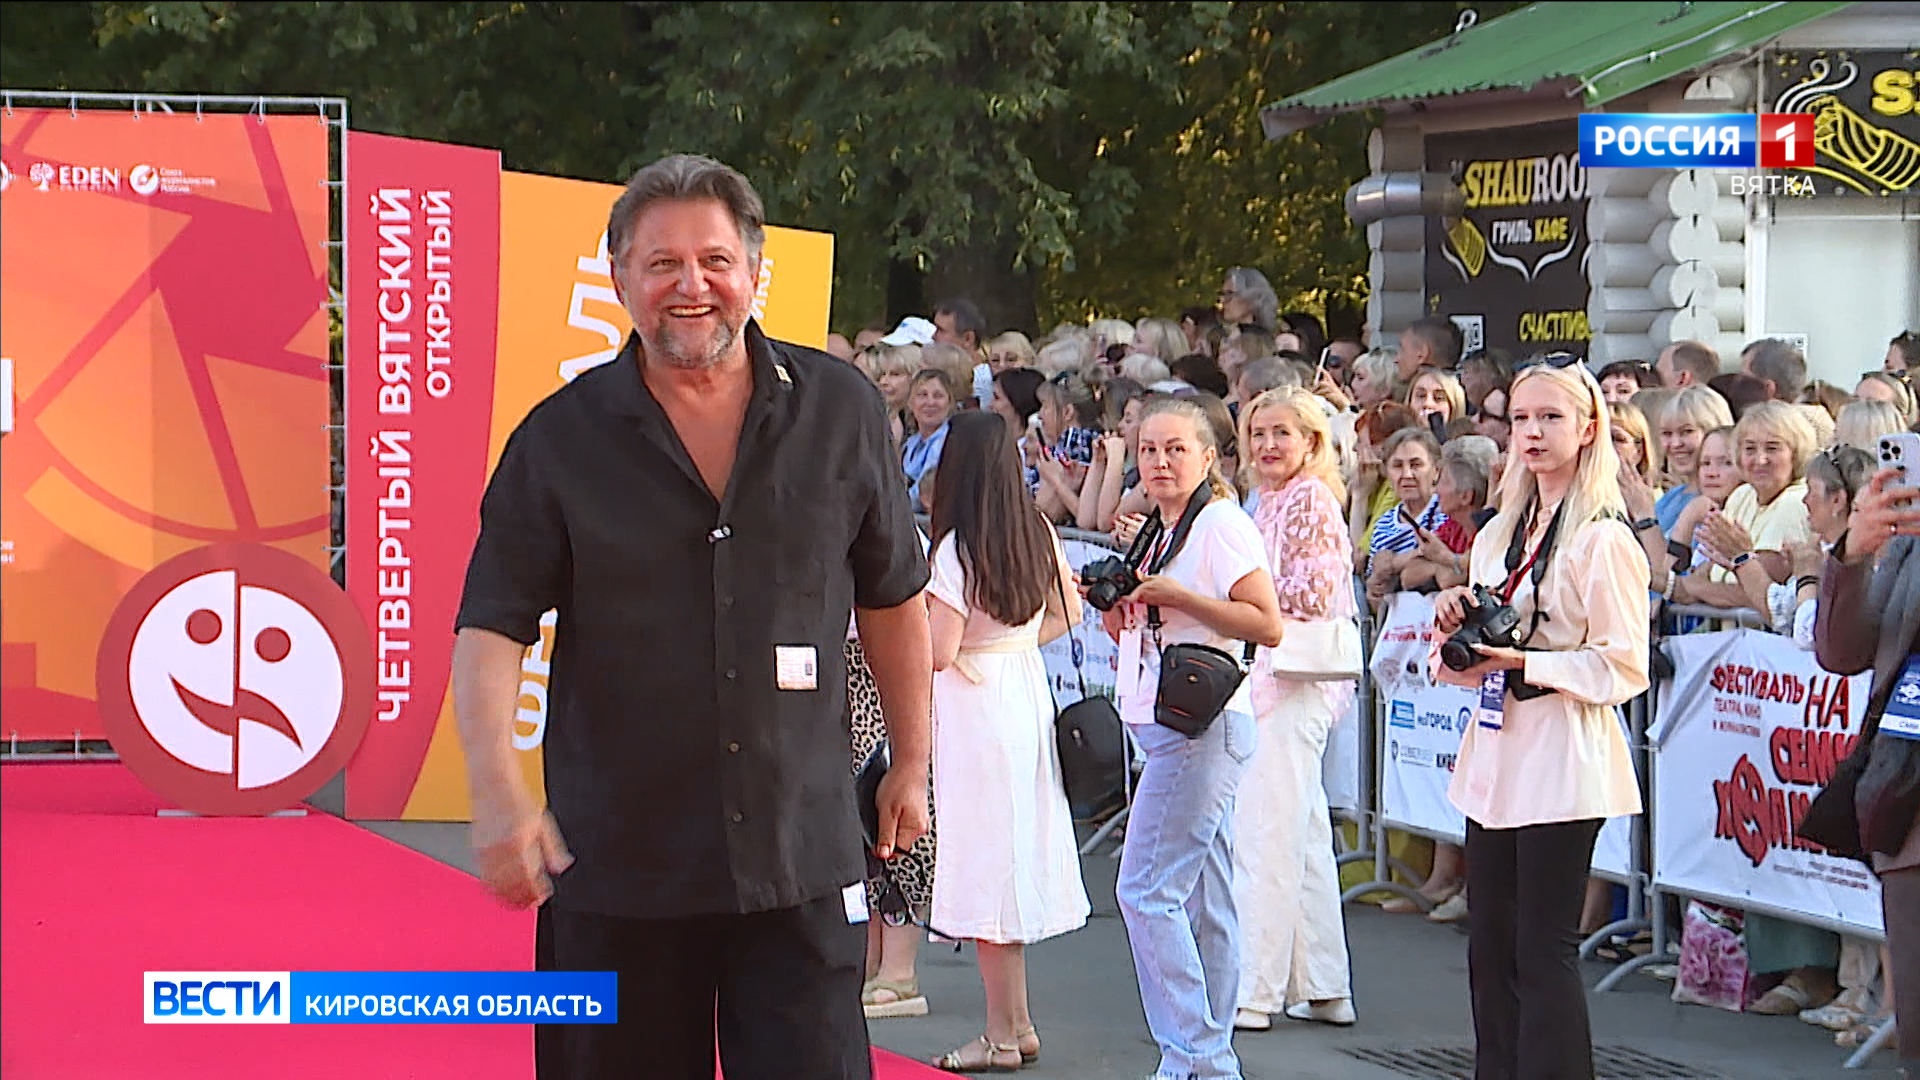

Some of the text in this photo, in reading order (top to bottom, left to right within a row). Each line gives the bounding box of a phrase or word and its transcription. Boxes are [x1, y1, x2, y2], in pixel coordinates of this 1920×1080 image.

[59, 166, 119, 185] EDEN
[1465, 152, 1590, 208] SHAUROO
[1492, 217, 1569, 244] ГРИЛЬ КАФЕ
[420, 190, 451, 397] ОТКРЫТЫЙ
[370, 188, 411, 721] ЧЕТВЕРТЫЙ ВЯТСКИЙ
[1710, 664, 1805, 704] ФЕСТИВАЛЬ
[1804, 674, 1849, 730] НА
